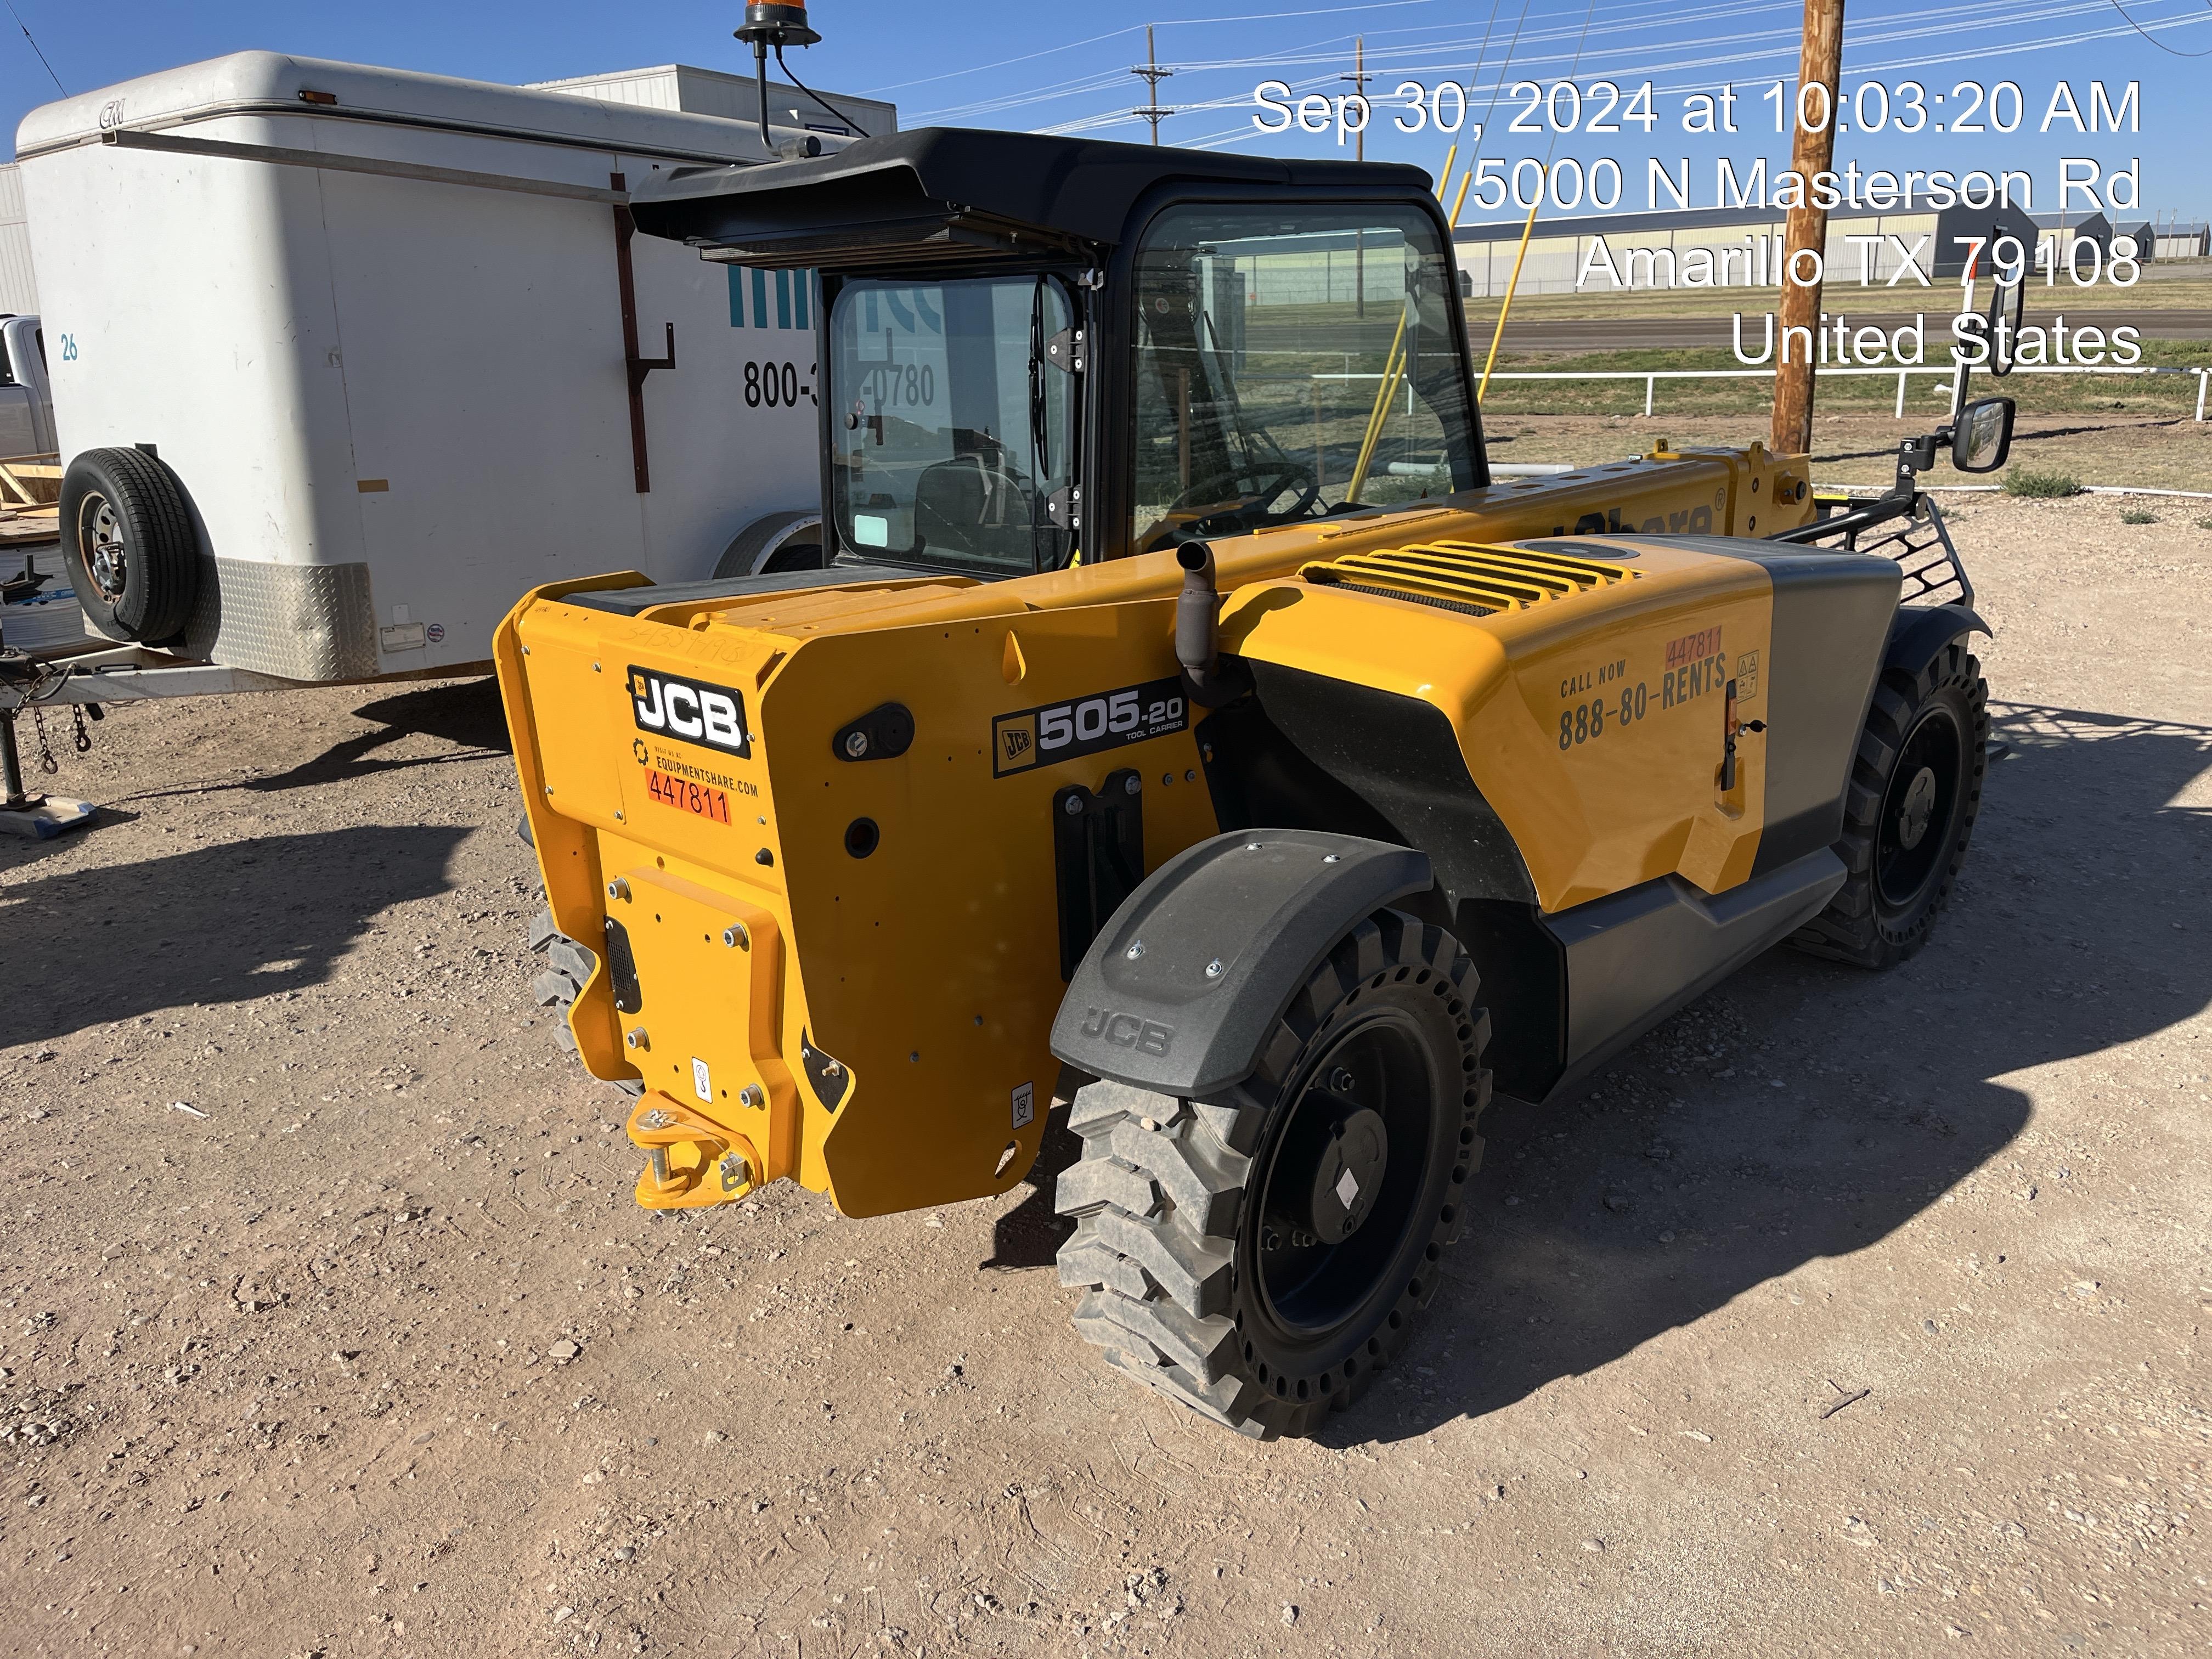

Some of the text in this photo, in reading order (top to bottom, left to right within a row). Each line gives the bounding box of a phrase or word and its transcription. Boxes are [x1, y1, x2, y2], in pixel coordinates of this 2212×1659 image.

[61, 333, 78, 361] 26
[1667, 625, 1722, 668] 447811
[1560, 659, 1626, 698] CALL NOW
[637, 678, 742, 750] JCB
[1039, 690, 1183, 751] 505-20
[1559, 651, 1726, 752] 888-80-RENTS
[1006, 730, 1030, 757] JCB
[1126, 720, 1183, 741] TOOL CARRIER
[650, 771, 729, 823] 447811
[656, 756, 759, 798] EQUIPMENTSHARE.COM
[1080, 1005, 1176, 1058] JCB
